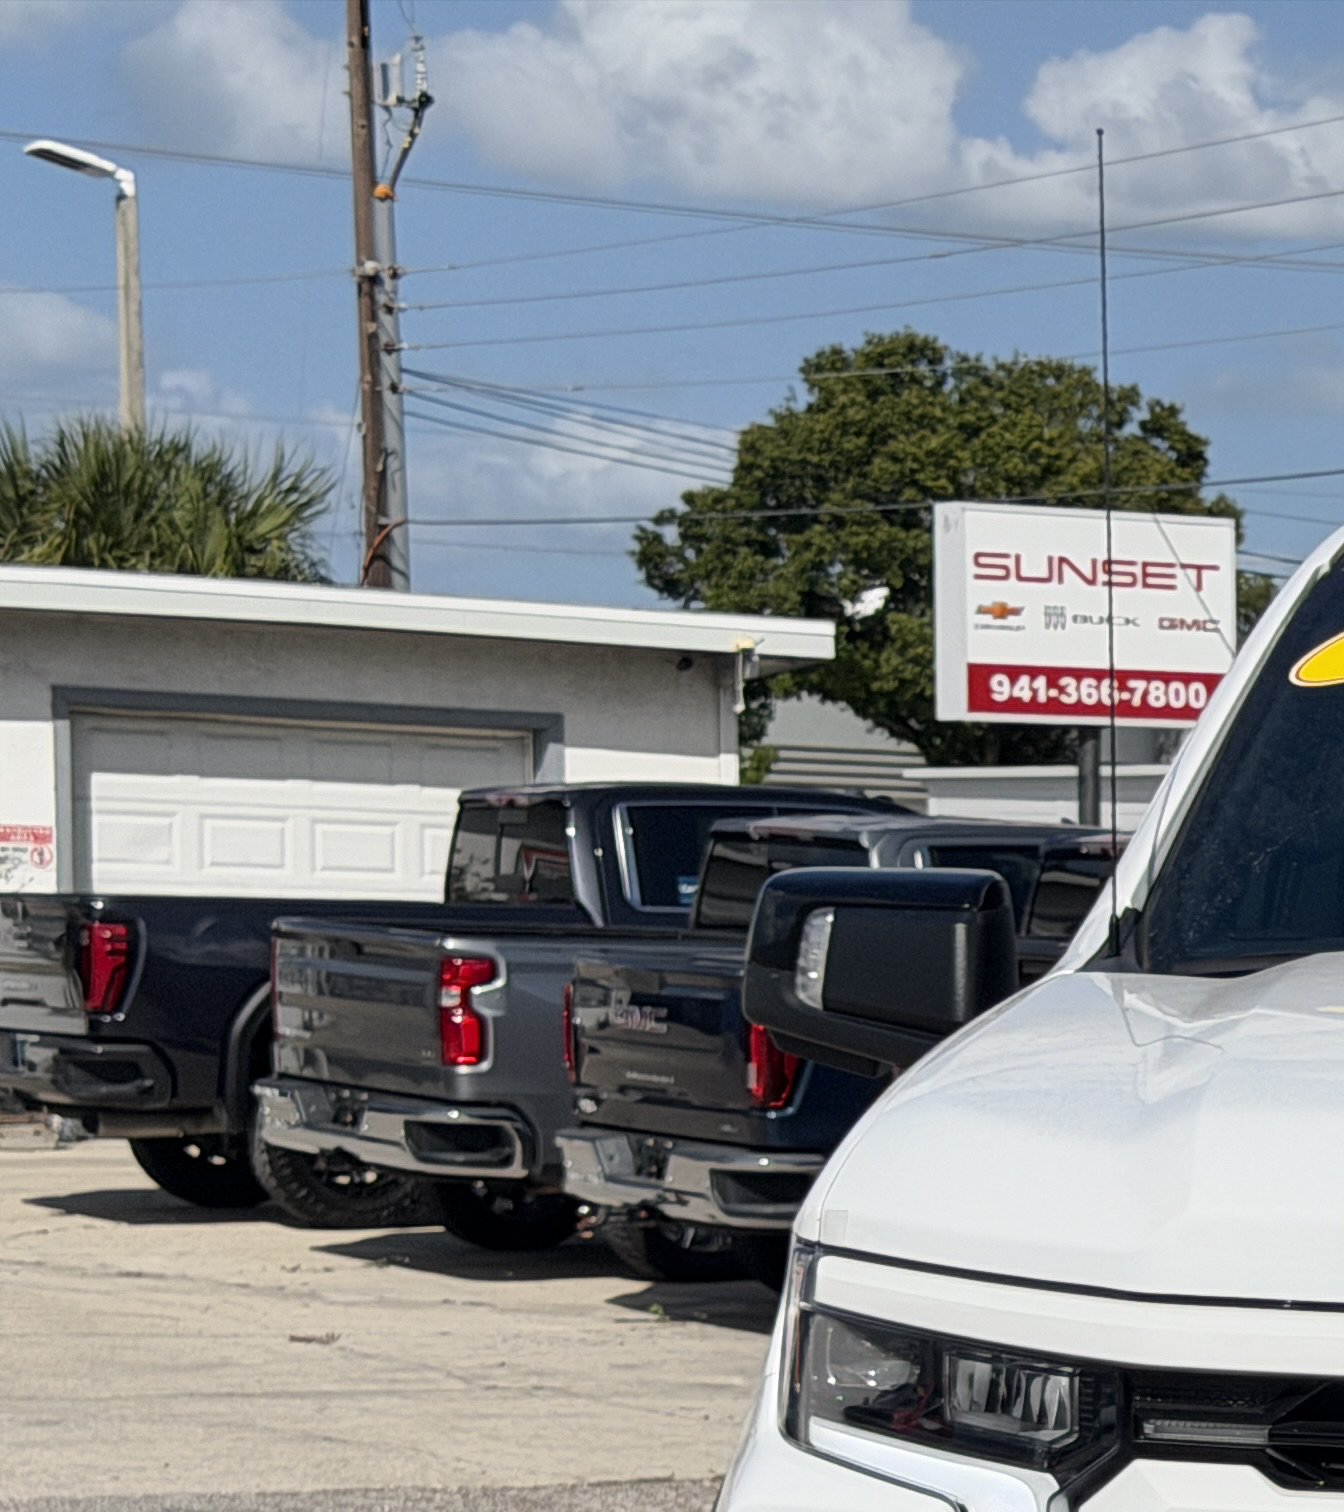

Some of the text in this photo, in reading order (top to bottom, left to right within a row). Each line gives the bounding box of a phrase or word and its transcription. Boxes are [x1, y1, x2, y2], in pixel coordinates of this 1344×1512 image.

[973, 552, 1220, 592] SUNSET
[1071, 613, 1141, 628] BUCK
[1157, 616, 1221, 633] GMC
[989, 673, 1208, 709] 941-366-7800
